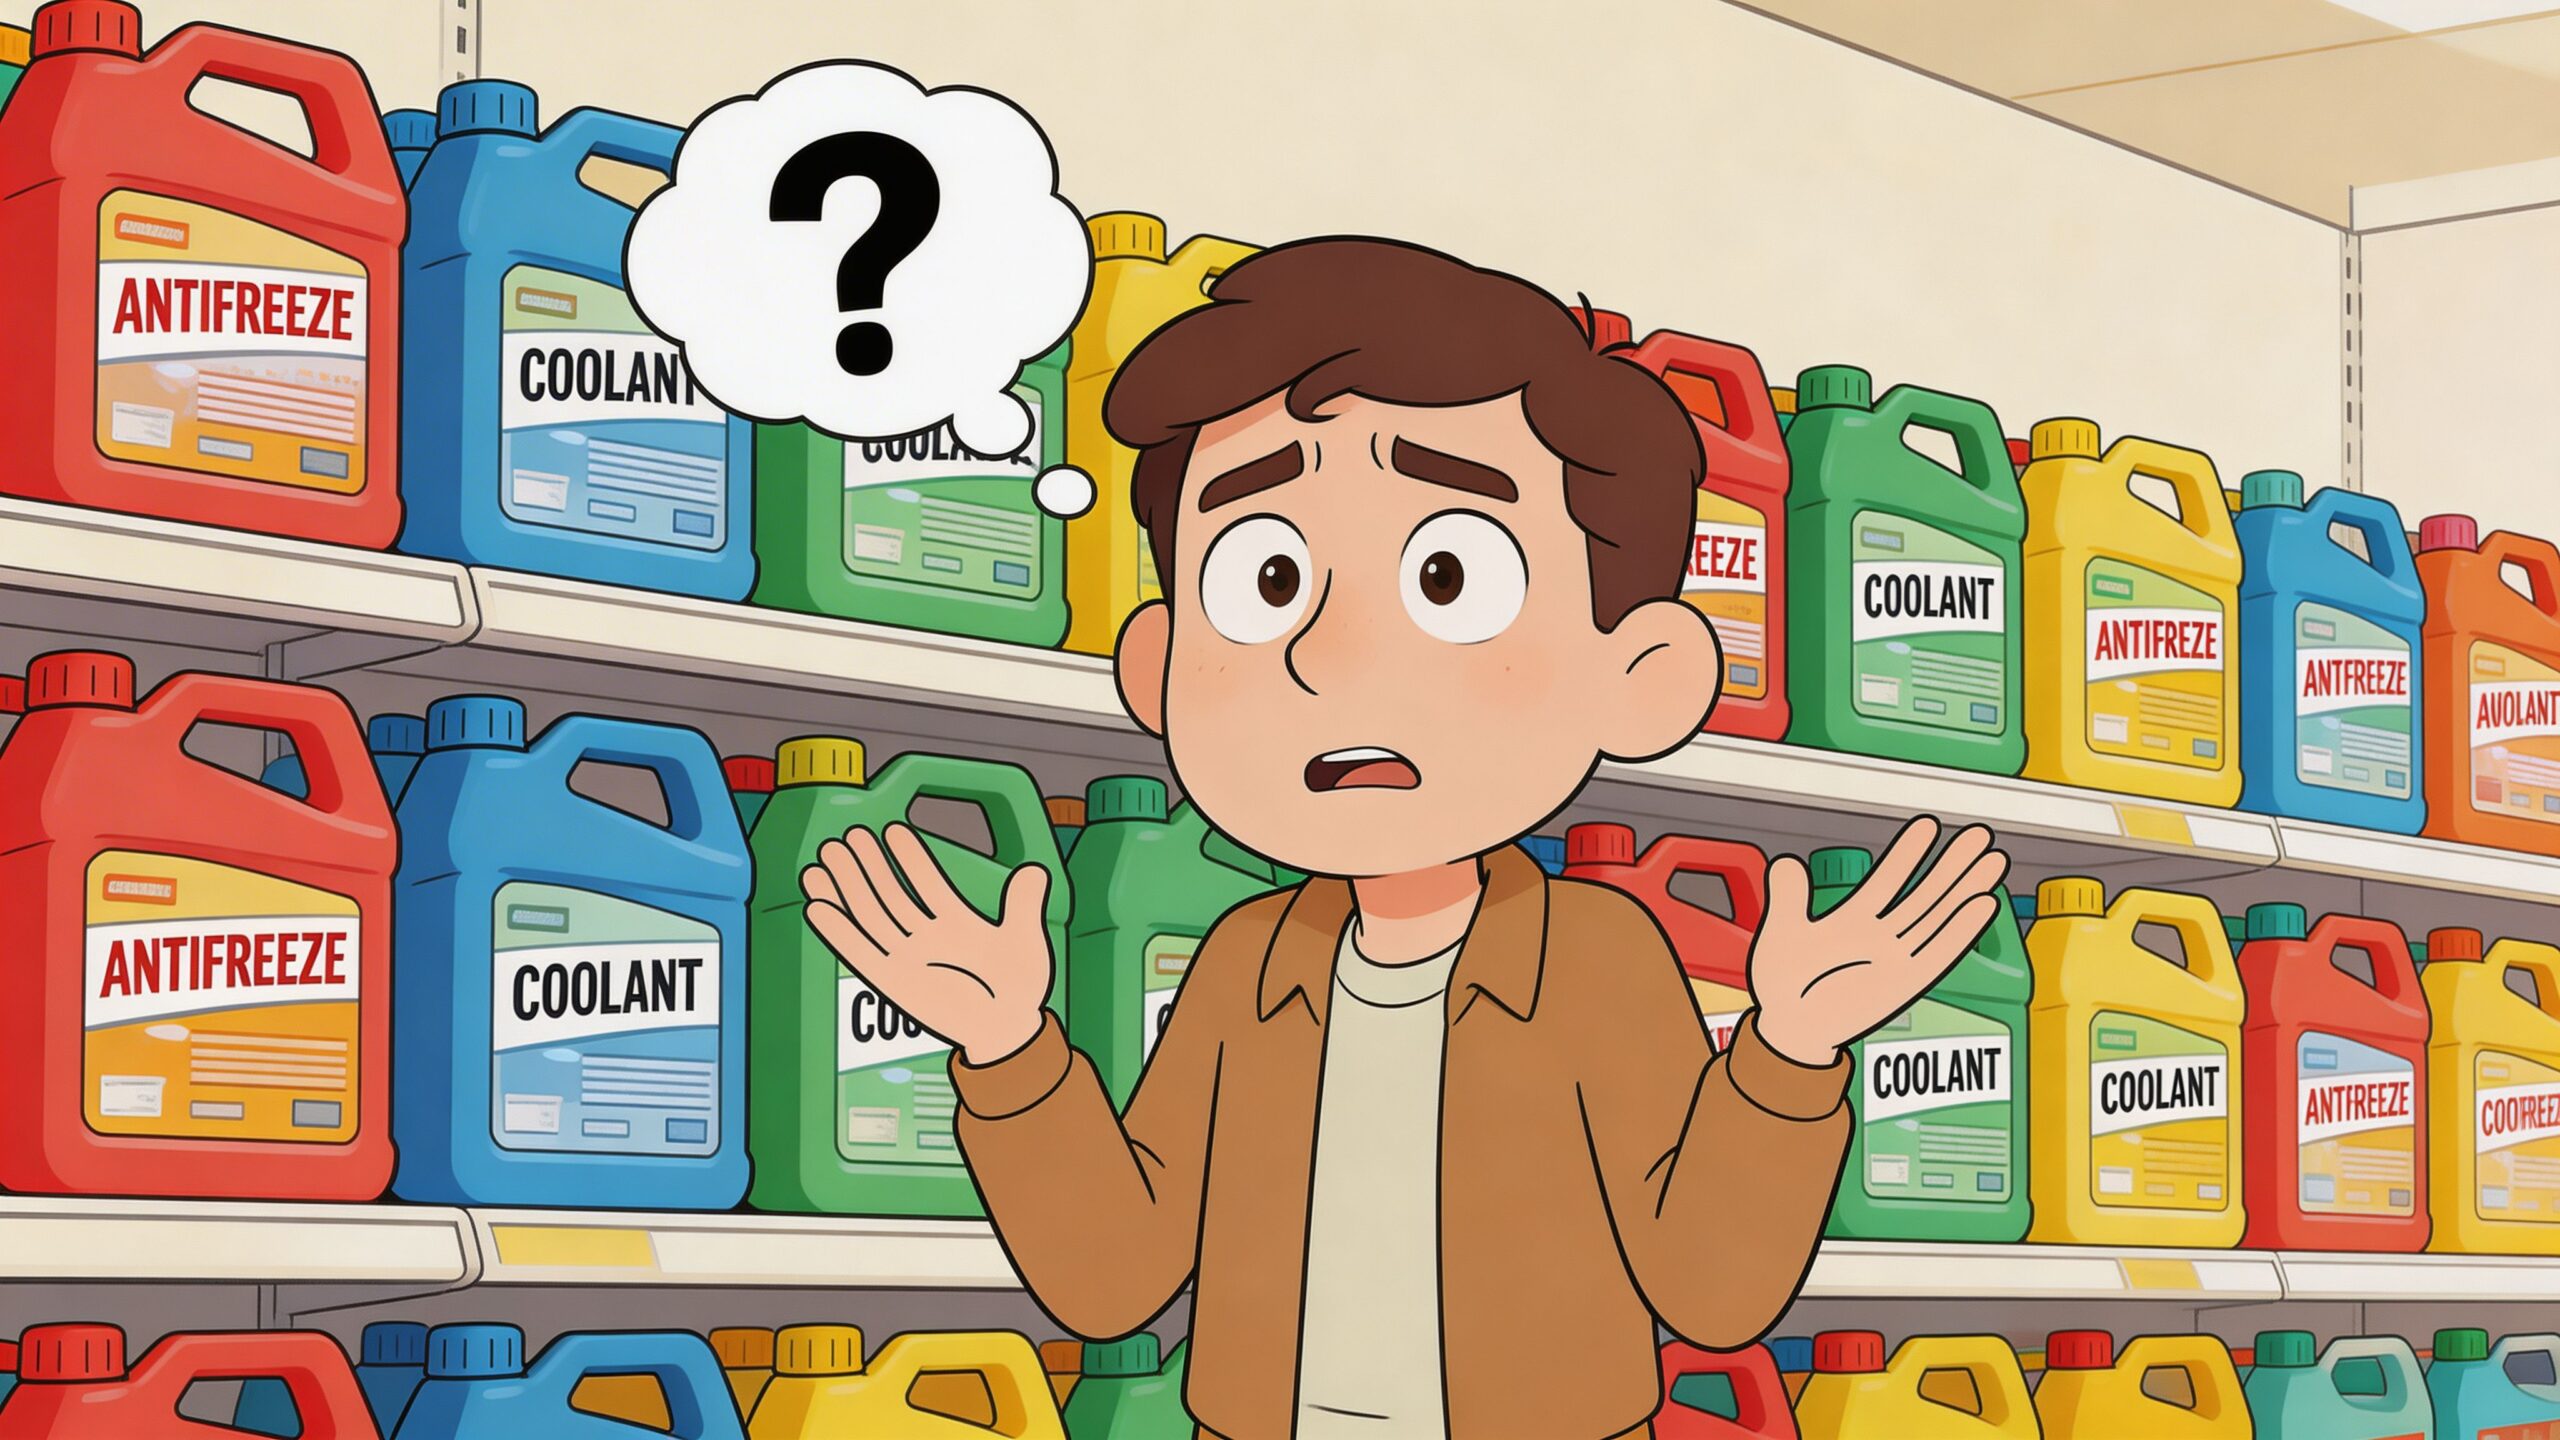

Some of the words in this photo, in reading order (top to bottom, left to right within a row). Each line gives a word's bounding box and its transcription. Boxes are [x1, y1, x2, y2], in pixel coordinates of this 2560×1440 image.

[113, 278, 354, 341] ANTIFREEZE
[1688, 535, 1757, 580] EEZE
[1864, 574, 1994, 619] COOLANT
[2095, 620, 2217, 660] ANTIFREZE
[2303, 659, 2407, 697] ANTFREEZE
[100, 932, 347, 998] ANTIFREEZE
[513, 958, 703, 1021] COOLANT
[1873, 1048, 2001, 1099] COOLANT
[2101, 1066, 2220, 1115] COOLANT
